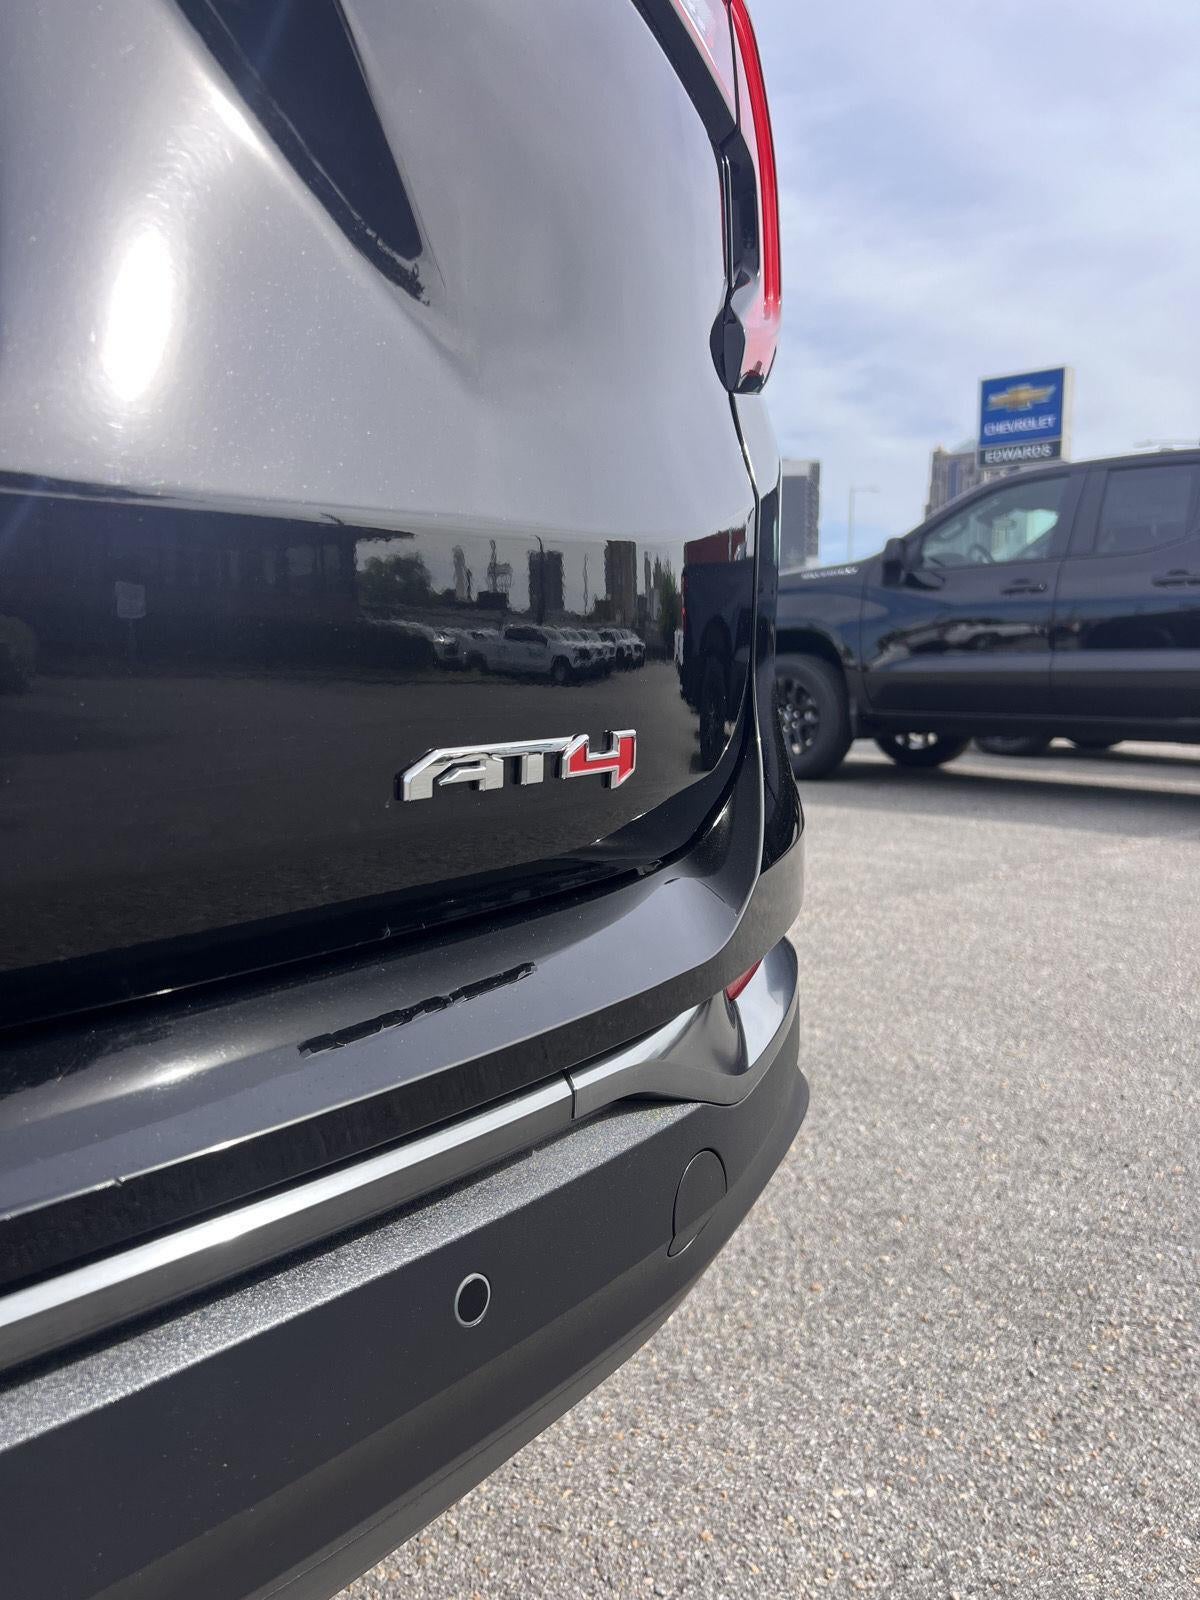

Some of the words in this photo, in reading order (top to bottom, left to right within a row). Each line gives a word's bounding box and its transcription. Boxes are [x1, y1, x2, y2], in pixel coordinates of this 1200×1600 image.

[984, 415, 1056, 436] CHEVROLET
[985, 444, 1051, 463] EDWARDS
[400, 729, 637, 801] AT4
